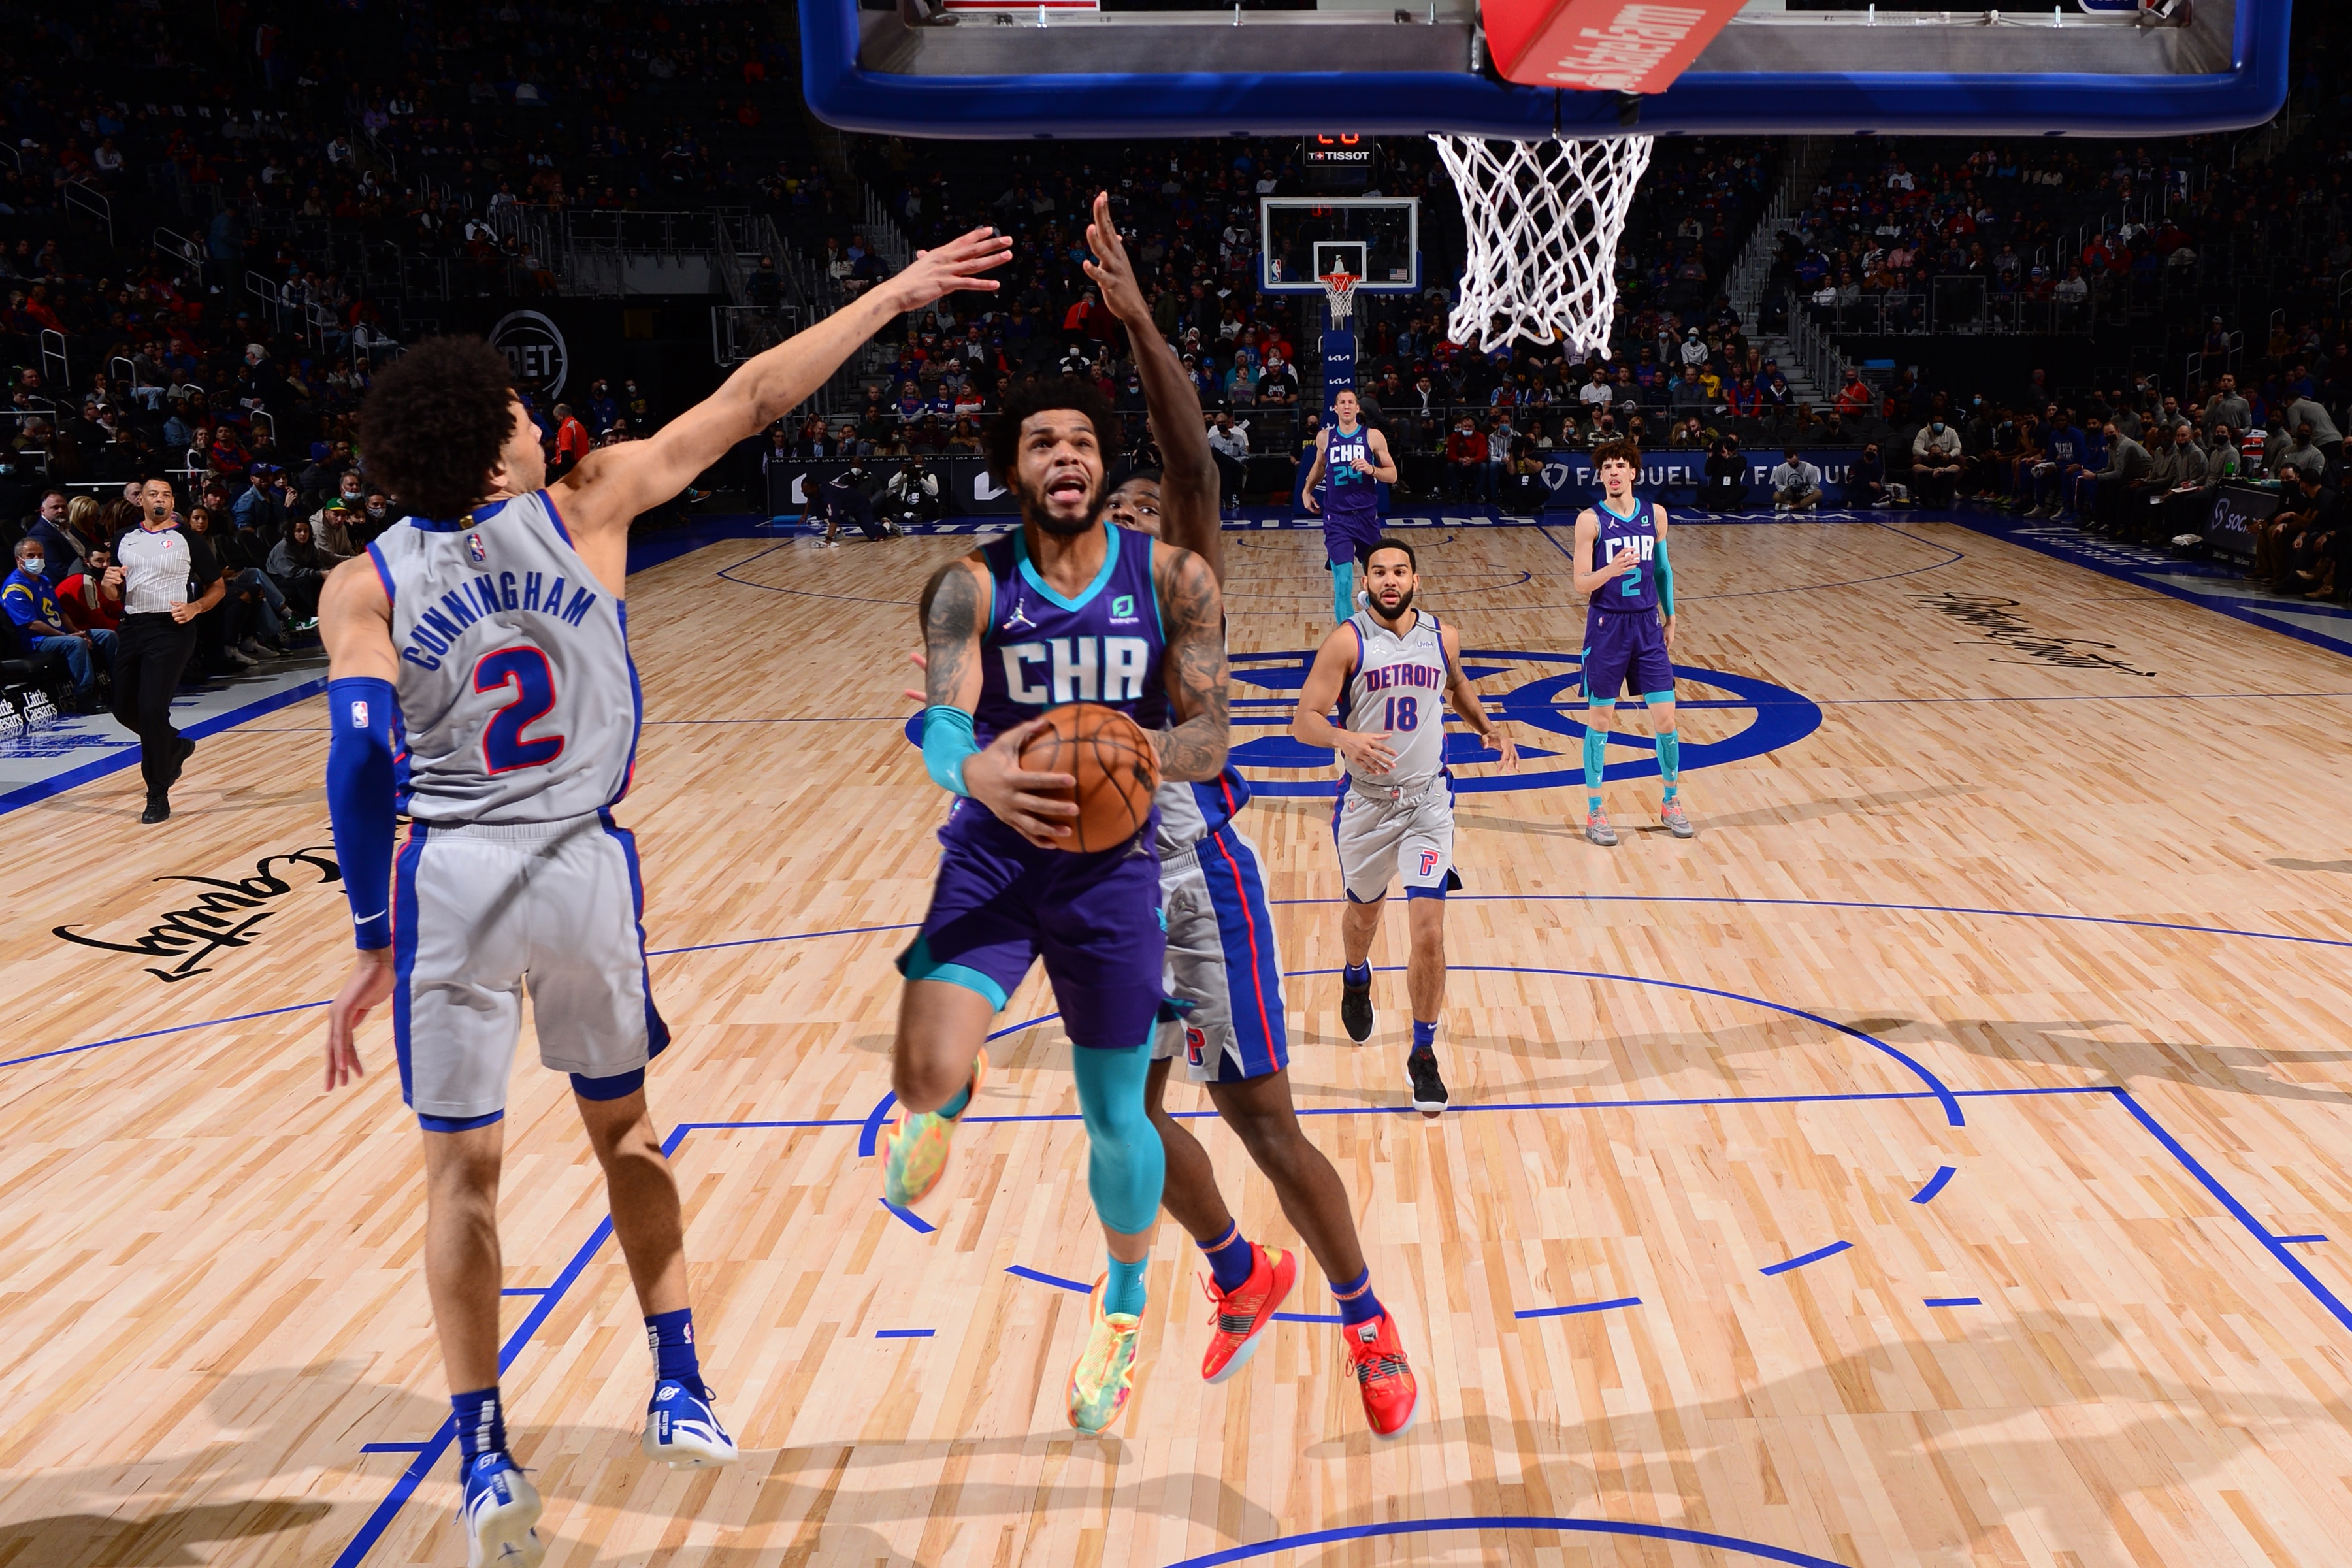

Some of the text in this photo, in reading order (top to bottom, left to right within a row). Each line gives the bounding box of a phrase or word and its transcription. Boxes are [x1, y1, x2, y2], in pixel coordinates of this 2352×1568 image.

[1325, 152, 1371, 161] TISSOT
[1330, 444, 1365, 464] CHA
[1333, 466, 1363, 486] 24
[1604, 535, 1655, 572] CHA
[1622, 567, 1642, 597] 2
[402, 570, 597, 672] CUNNINGHAM
[998, 635, 1149, 704] CHA
[1364, 663, 1441, 693] DETROIT
[23, 689, 50, 708] Little
[24, 703, 57, 723] Caesars
[473, 645, 565, 776] 2
[1384, 696, 1418, 732] 18
